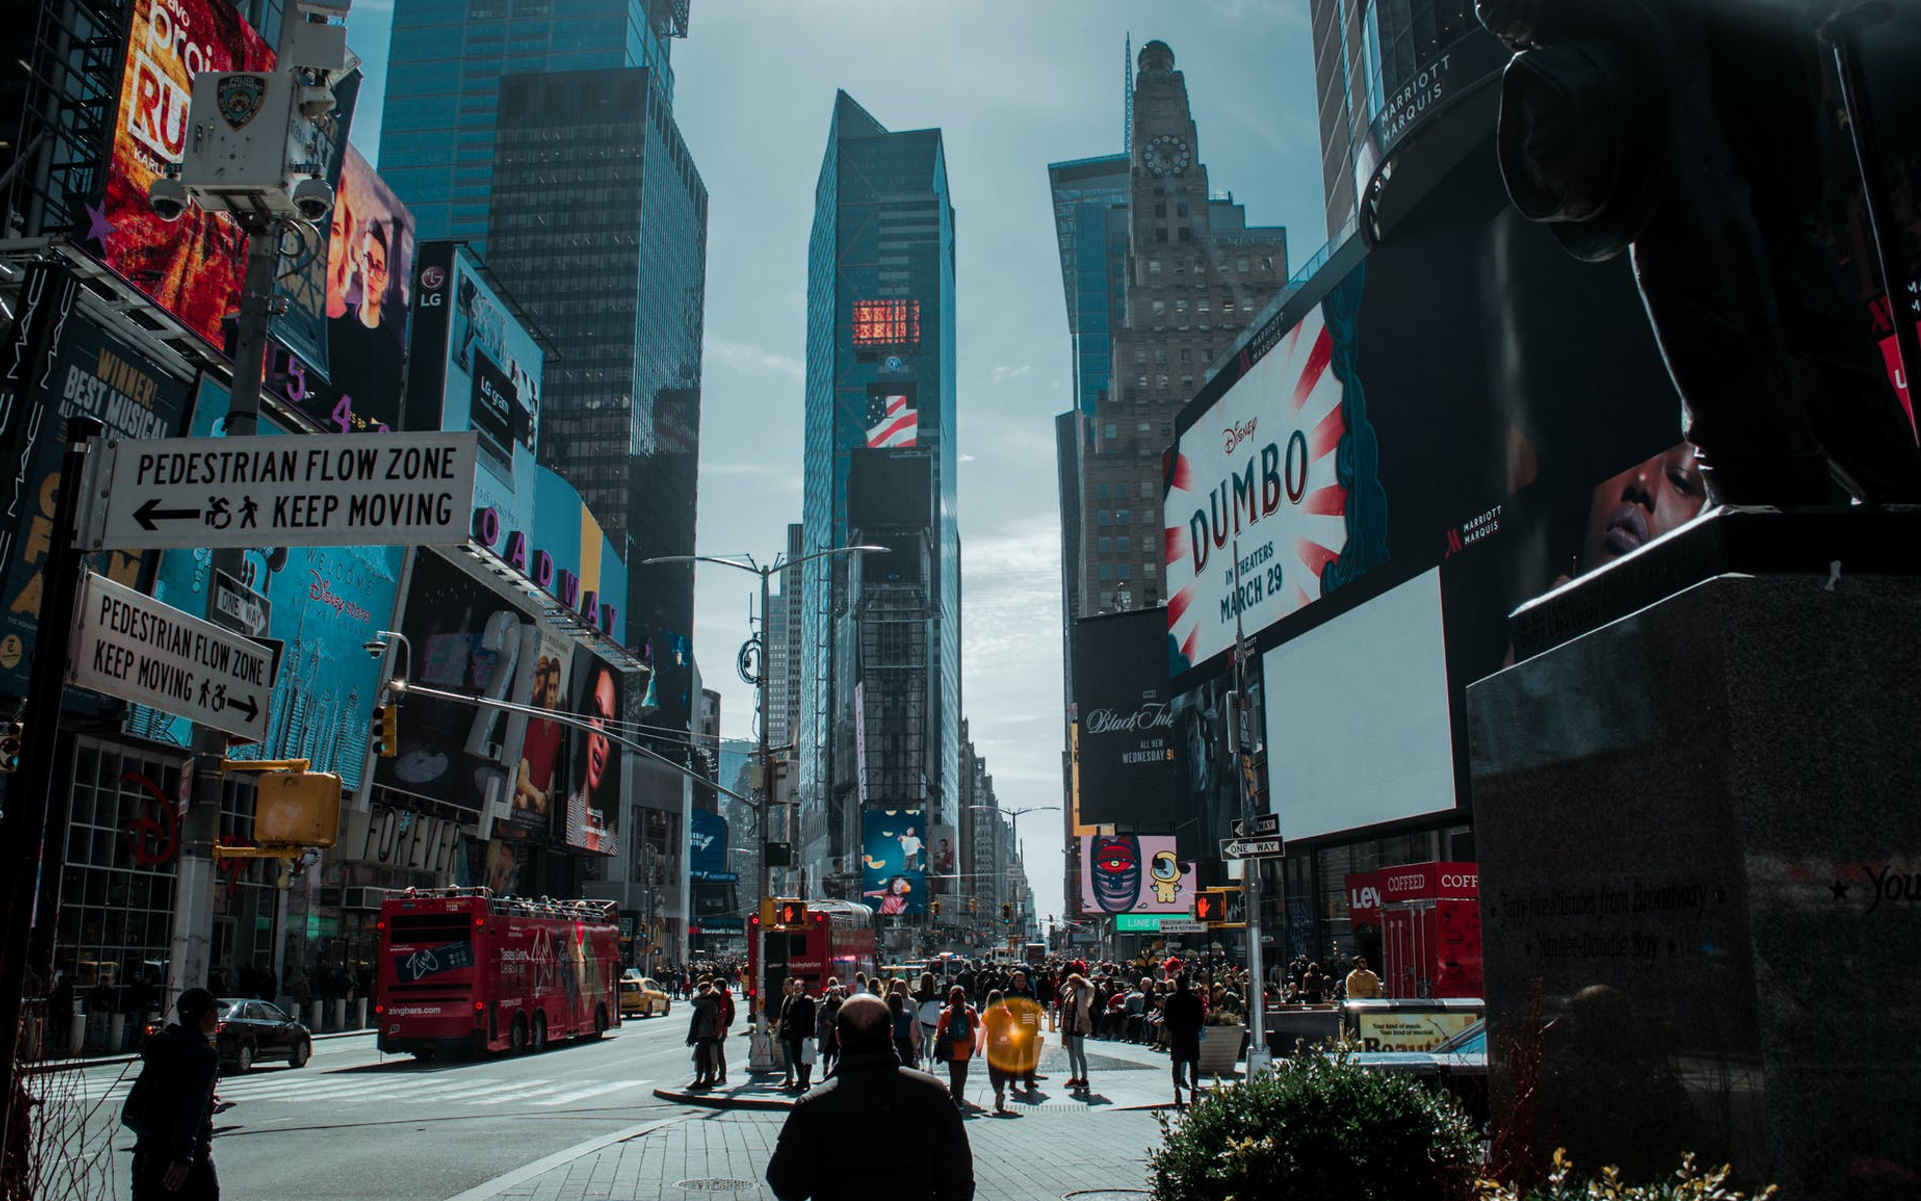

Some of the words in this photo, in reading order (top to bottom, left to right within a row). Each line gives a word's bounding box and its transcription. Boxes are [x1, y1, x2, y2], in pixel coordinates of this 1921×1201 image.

[1381, 53, 1450, 124] MARRIOTT
[1383, 82, 1442, 146] MARQUIS
[420, 293, 441, 307] LG
[97, 346, 158, 411] WINNER!
[480, 376, 492, 396] LG
[63, 363, 107, 418] BEST
[104, 388, 168, 442] MUSICAL
[1223, 417, 1257, 456] Disney
[137, 451, 298, 485] PEDESTRIAN
[305, 448, 379, 482] FLOW
[385, 447, 456, 480] ZONE
[272, 494, 339, 528] KEEP
[348, 493, 452, 526] MOVING
[1190, 429, 1308, 578] DUMBO
[1463, 504, 1502, 534] MARRIOTT
[1464, 520, 1499, 545] MARQUIS
[1225, 567, 1235, 586] IN
[1237, 540, 1274, 579] THEATERS
[223, 591, 241, 617] ONE
[247, 602, 263, 632] WAY
[1220, 574, 1263, 624] MARCH
[1267, 563, 1284, 599] 29
[100, 595, 193, 659] PEDESTRIAN
[194, 633, 231, 673] FLOW
[231, 650, 265, 687] ZONE
[93, 639, 135, 681] KEEP
[136, 654, 195, 701] MOVING
[1086, 707, 1138, 735] Black
[1122, 749, 1165, 764] WEDNESDAY
[1257, 818, 1277, 832] WAY
[1231, 842, 1248, 854] ONE
[1256, 841, 1276, 853] WAY
[1387, 873, 1426, 892] COFFEED
